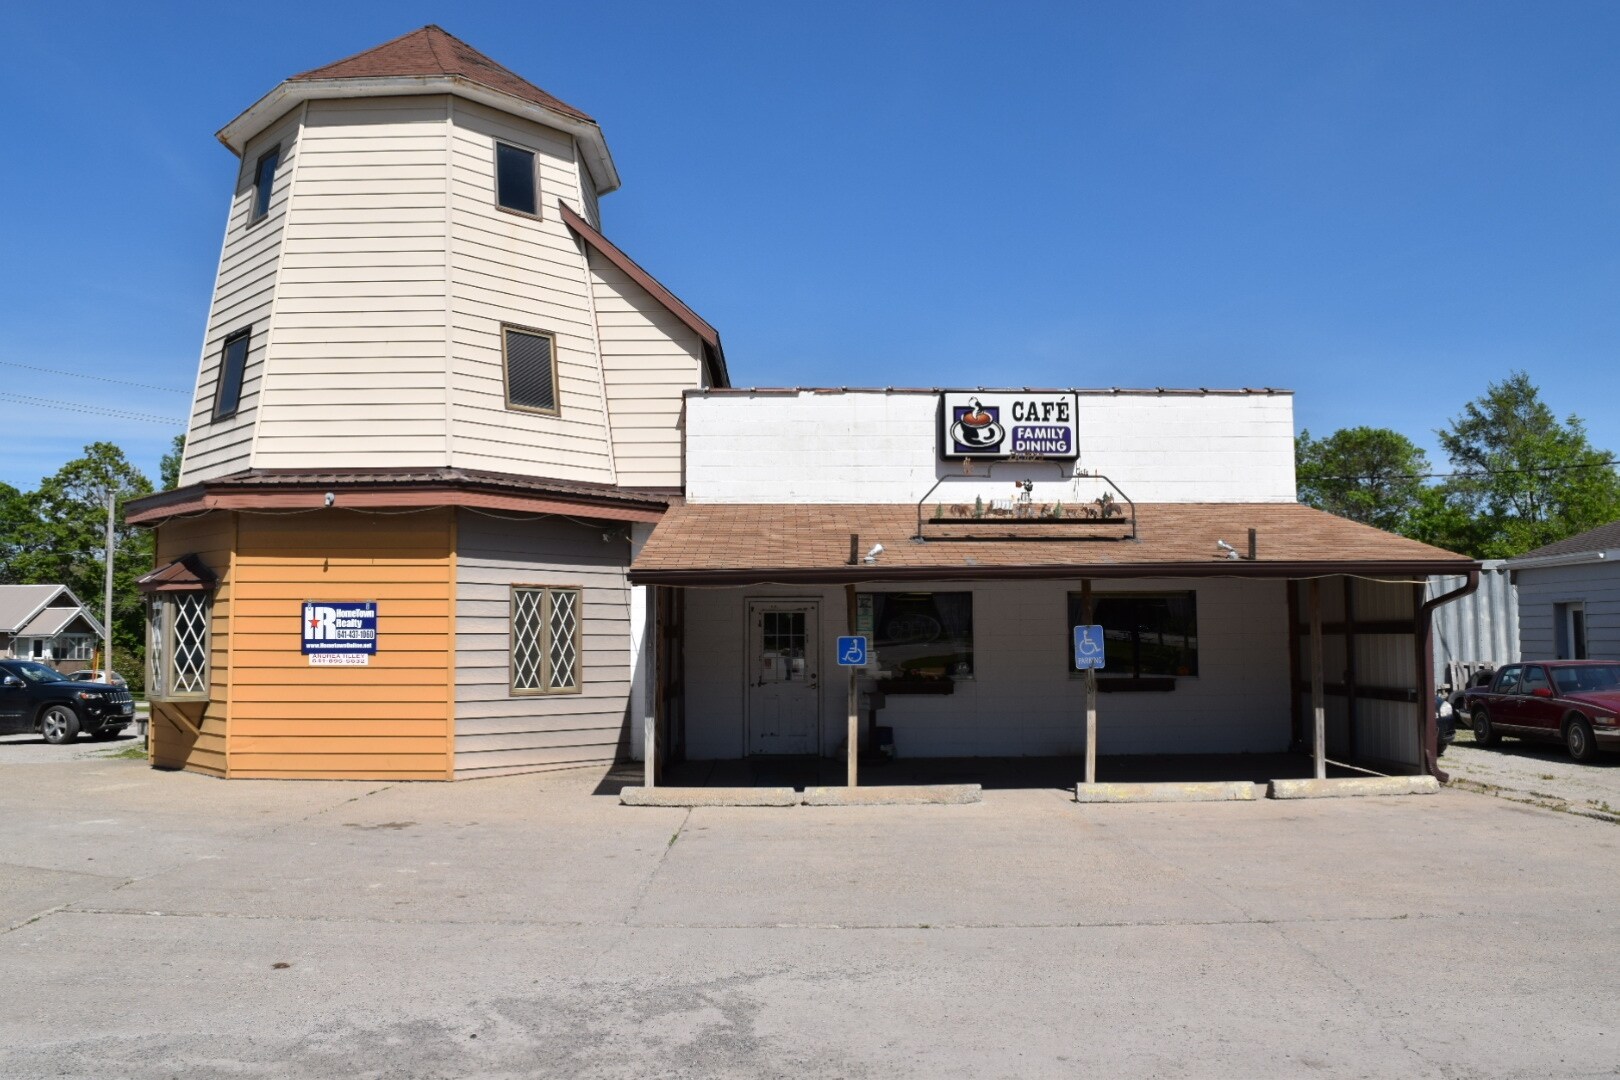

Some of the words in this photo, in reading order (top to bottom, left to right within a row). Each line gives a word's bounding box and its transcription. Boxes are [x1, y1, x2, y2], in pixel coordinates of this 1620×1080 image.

[1012, 396, 1069, 422] CAFÉ
[1017, 428, 1065, 439] FAMILY
[1016, 441, 1067, 452] DINING
[336, 619, 362, 628] Realty
